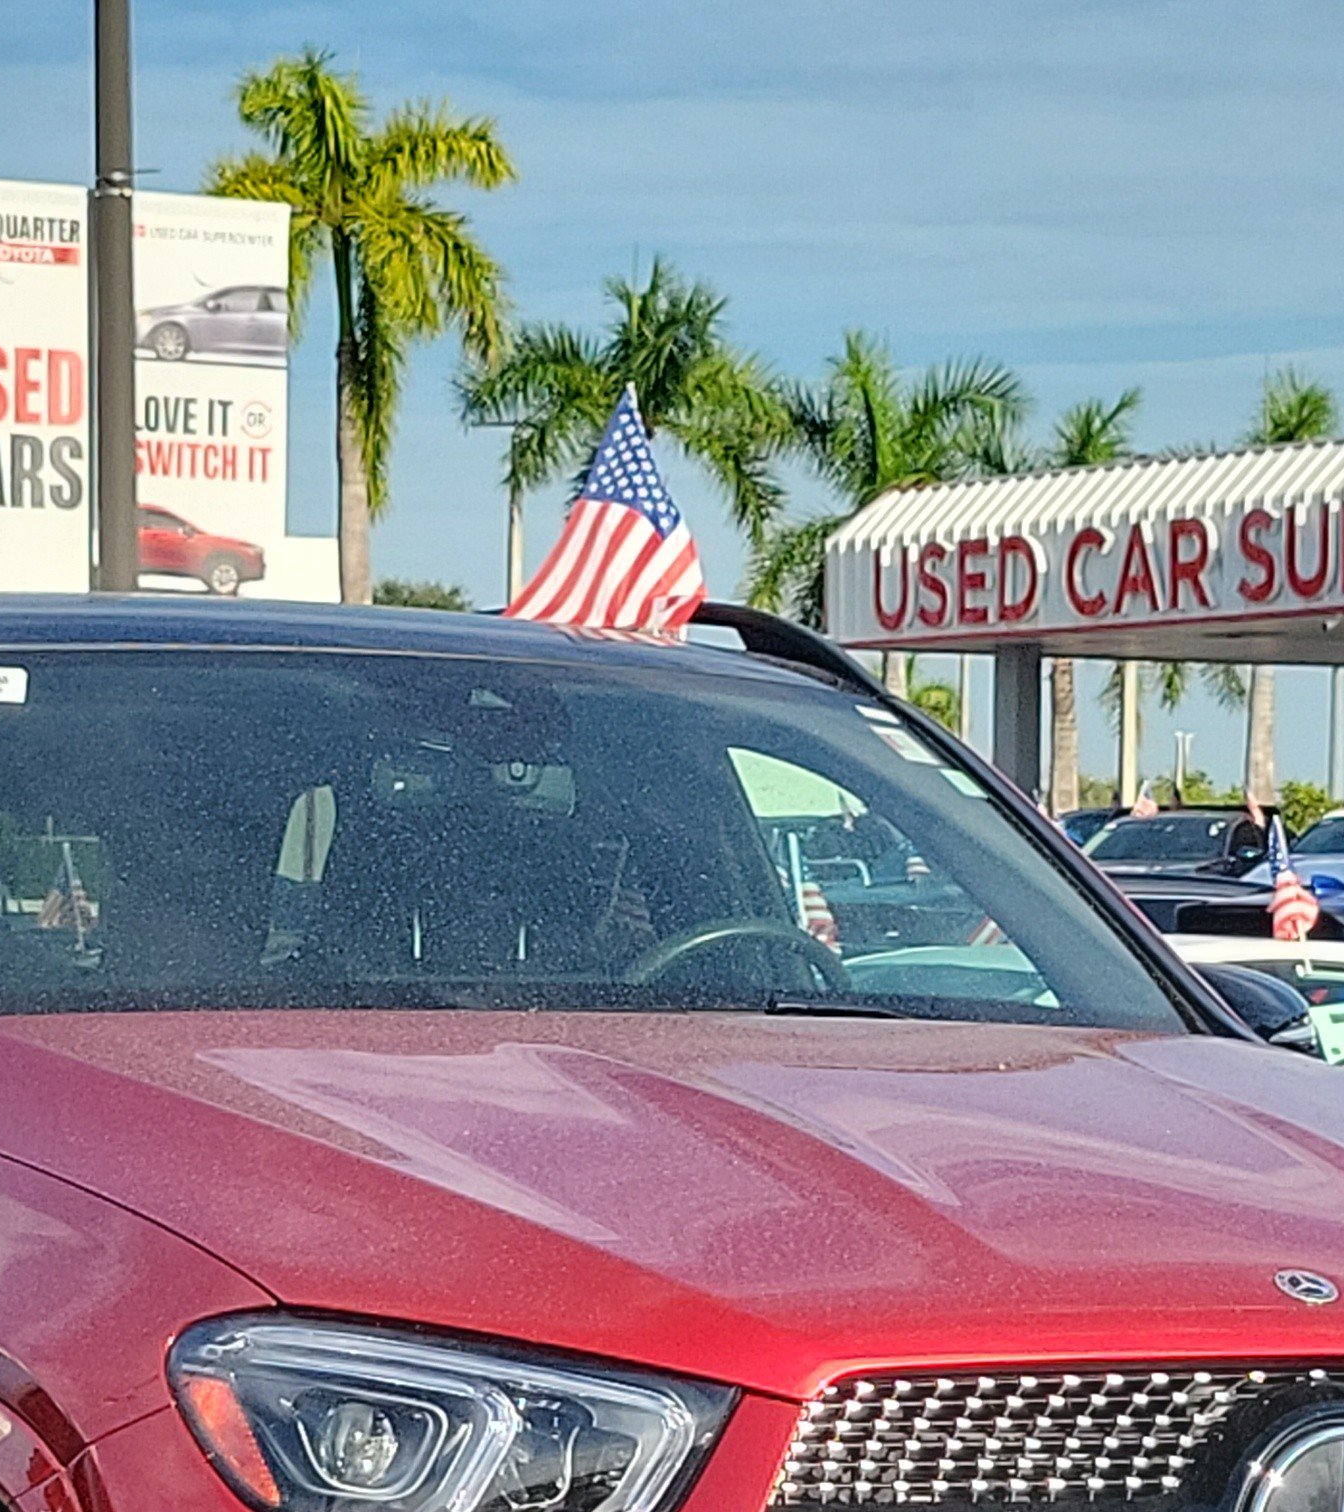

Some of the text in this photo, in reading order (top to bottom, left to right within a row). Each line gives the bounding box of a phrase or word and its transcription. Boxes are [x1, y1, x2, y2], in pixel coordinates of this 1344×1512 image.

[208, 399, 234, 437] IT
[247, 411, 266, 428] OR
[249, 446, 273, 482] IT
[872, 532, 1046, 631] USED
[1065, 517, 1216, 617] CAR
